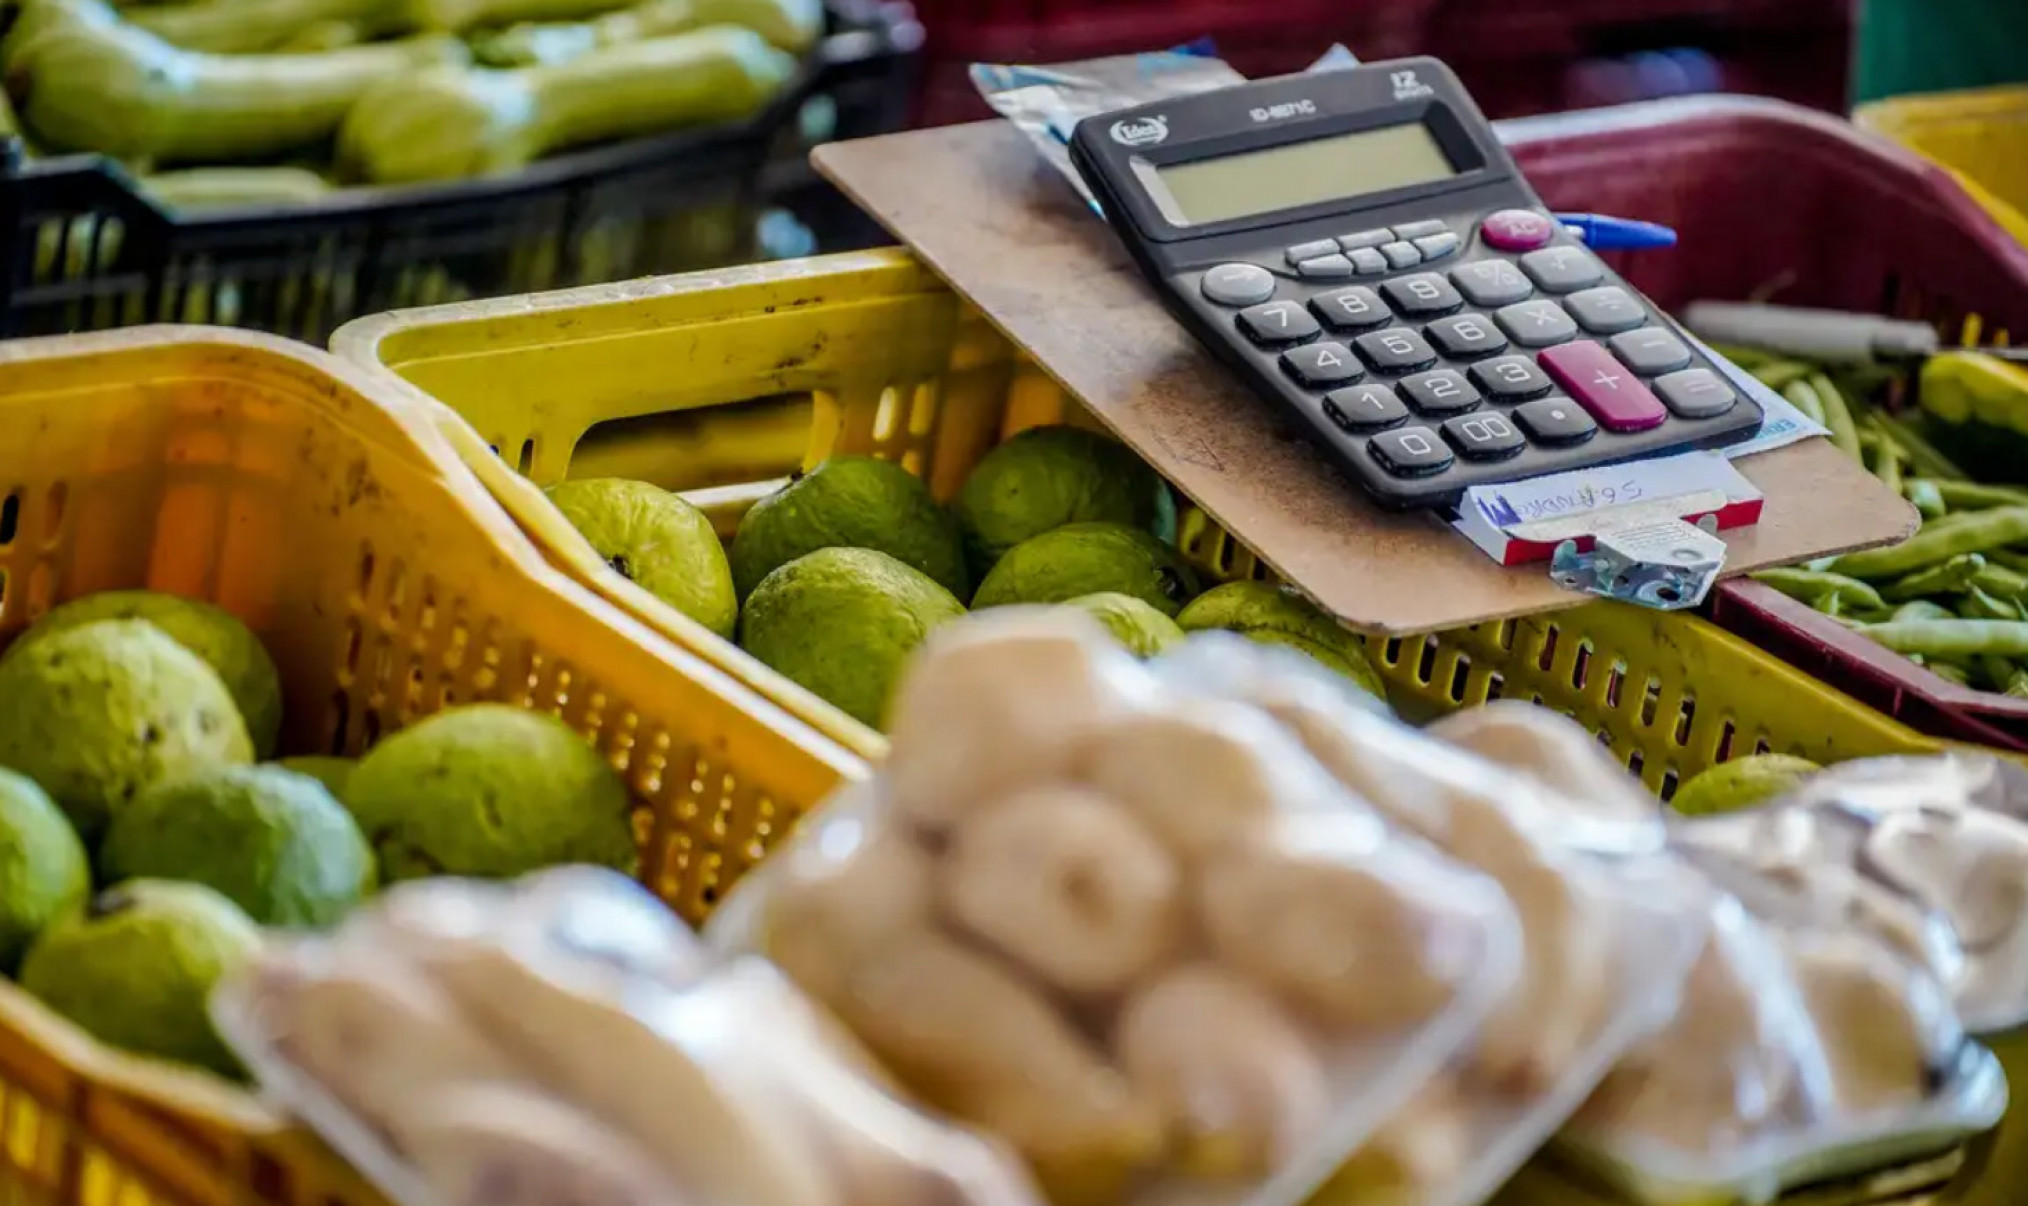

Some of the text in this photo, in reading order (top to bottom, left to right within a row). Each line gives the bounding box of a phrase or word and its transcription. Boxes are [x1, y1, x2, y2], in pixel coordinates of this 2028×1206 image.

[1390, 71, 1419, 88] 12
[1263, 308, 1288, 327] 7
[1337, 293, 1369, 313] 8
[1408, 279, 1439, 299] 9
[1317, 350, 1342, 368] 4
[1381, 336, 1414, 354] 5
[1453, 321, 1486, 341] 6
[1360, 392, 1384, 410] 1
[1423, 376, 1461, 398] 2
[1496, 362, 1531, 383] 3
[1400, 434, 1432, 455] 0
[1462, 417, 1510, 442] 00
